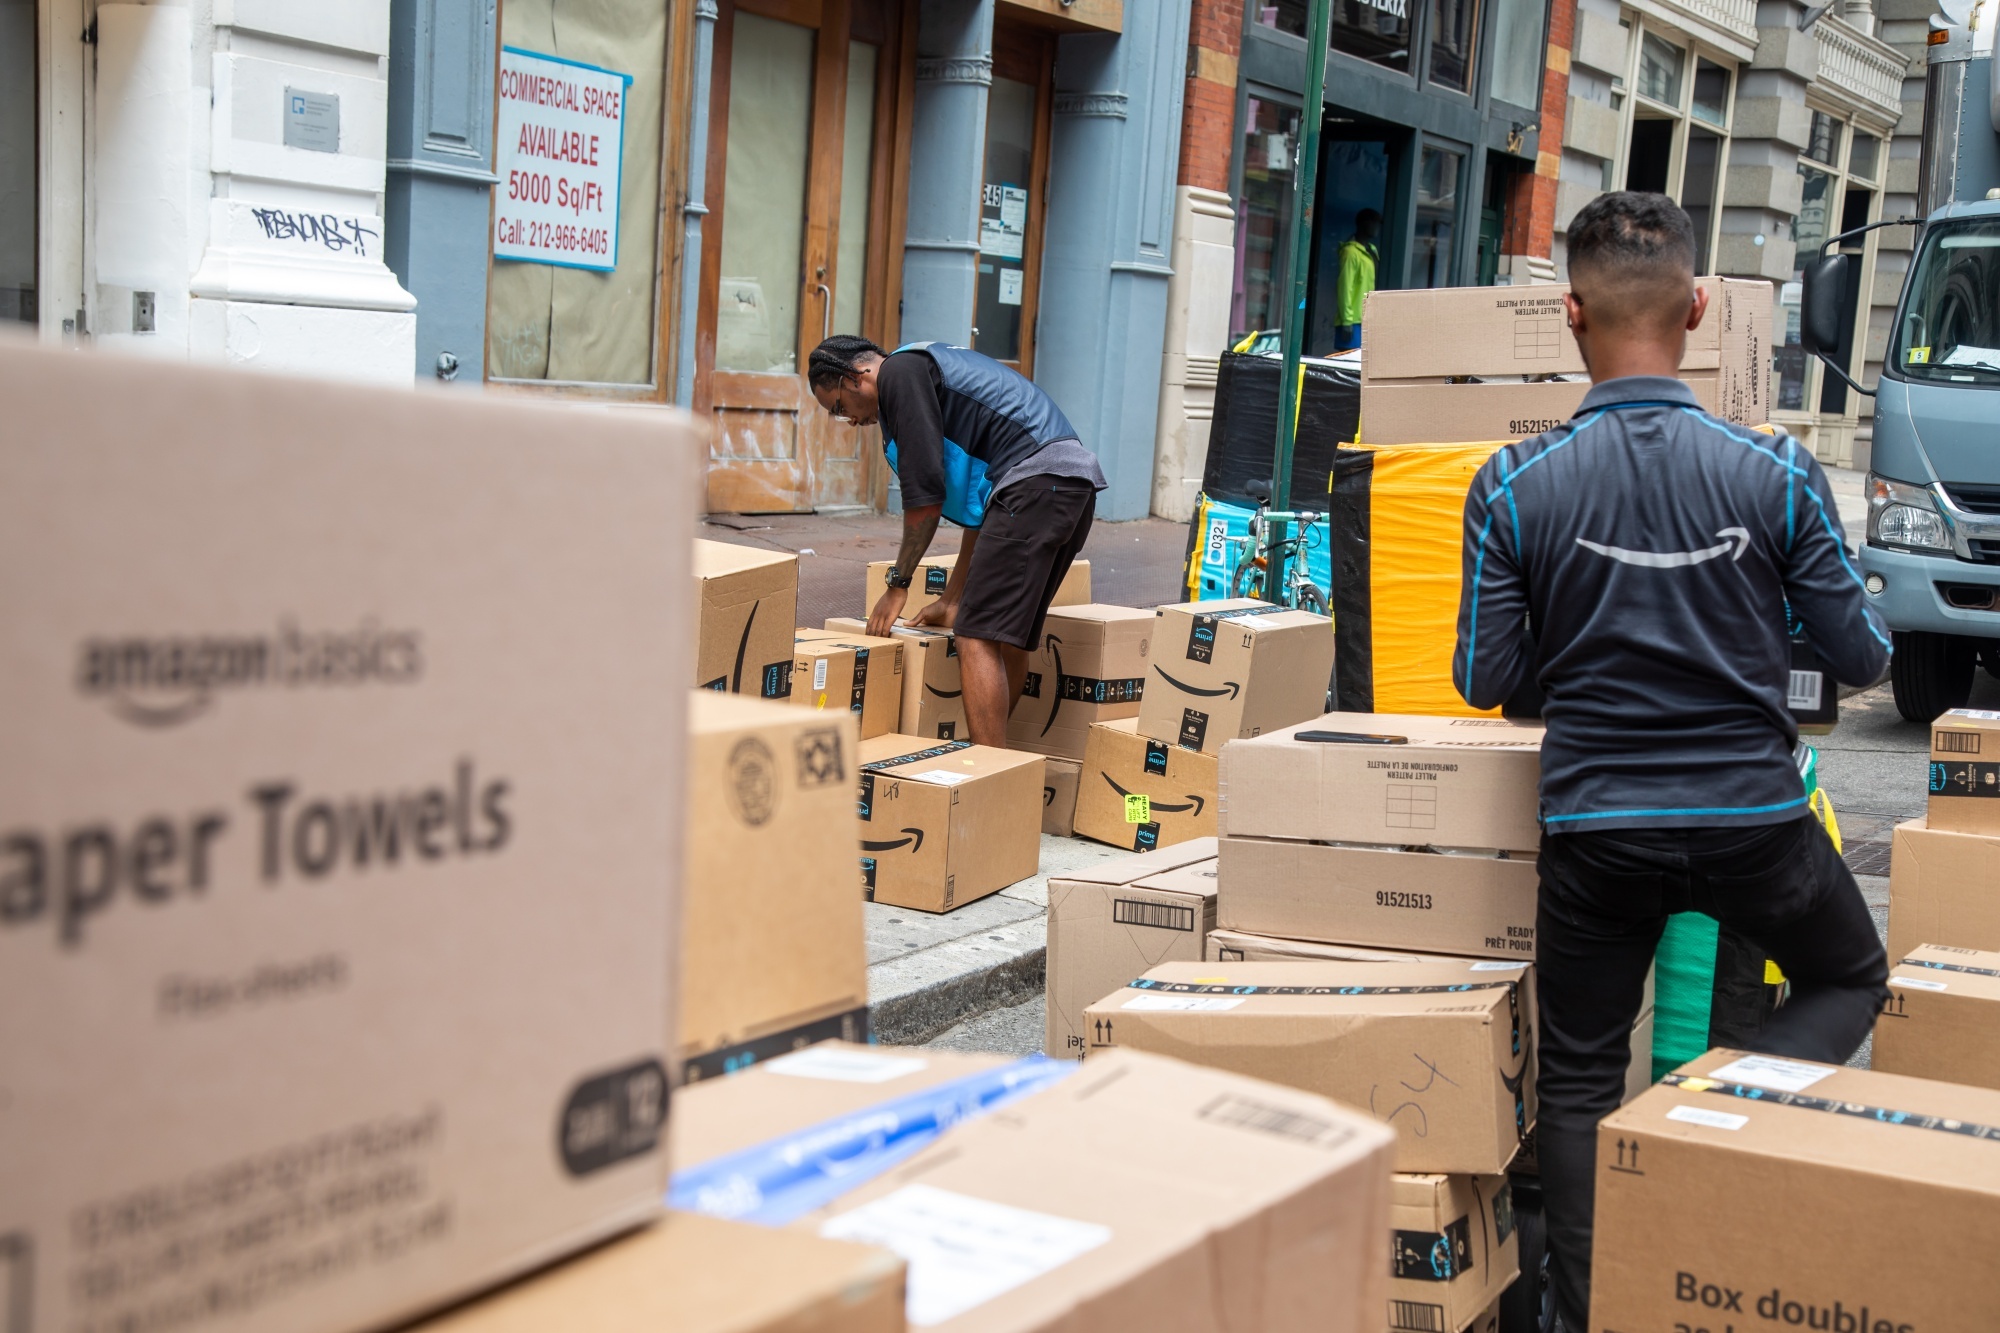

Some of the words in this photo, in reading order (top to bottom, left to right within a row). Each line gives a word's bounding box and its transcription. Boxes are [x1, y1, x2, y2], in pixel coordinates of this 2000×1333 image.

[500, 69, 579, 112] COMMERCIAL
[583, 86, 619, 120] SPACE
[518, 122, 599, 166] AVAILABLE
[509, 170, 551, 204] 5000
[557, 178, 603, 217] Sq/Ft
[498, 217, 525, 245] Call:
[529, 221, 608, 255] 212-966-6405
[1212, 526, 1224, 549] 032
[1194, 632, 1213, 642] prime
[1148, 757, 1165, 766] prime
[1367, 760, 1391, 768] PALETTE
[1410, 763, 1458, 772] CONFIGURATION
[1388, 772, 1413, 780] PATTERN
[1415, 772, 1437, 780] PALLET
[1138, 830, 1156, 840] prime
[0, 806, 226, 950] aper
[247, 755, 514, 885] Towels
[1376, 890, 1432, 910] 91521513
[1507, 926, 1535, 938] READY
[1485, 936, 1506, 948] PRÊT
[1509, 940, 1532, 952] POUR
[1675, 1271, 1744, 1313] Box
